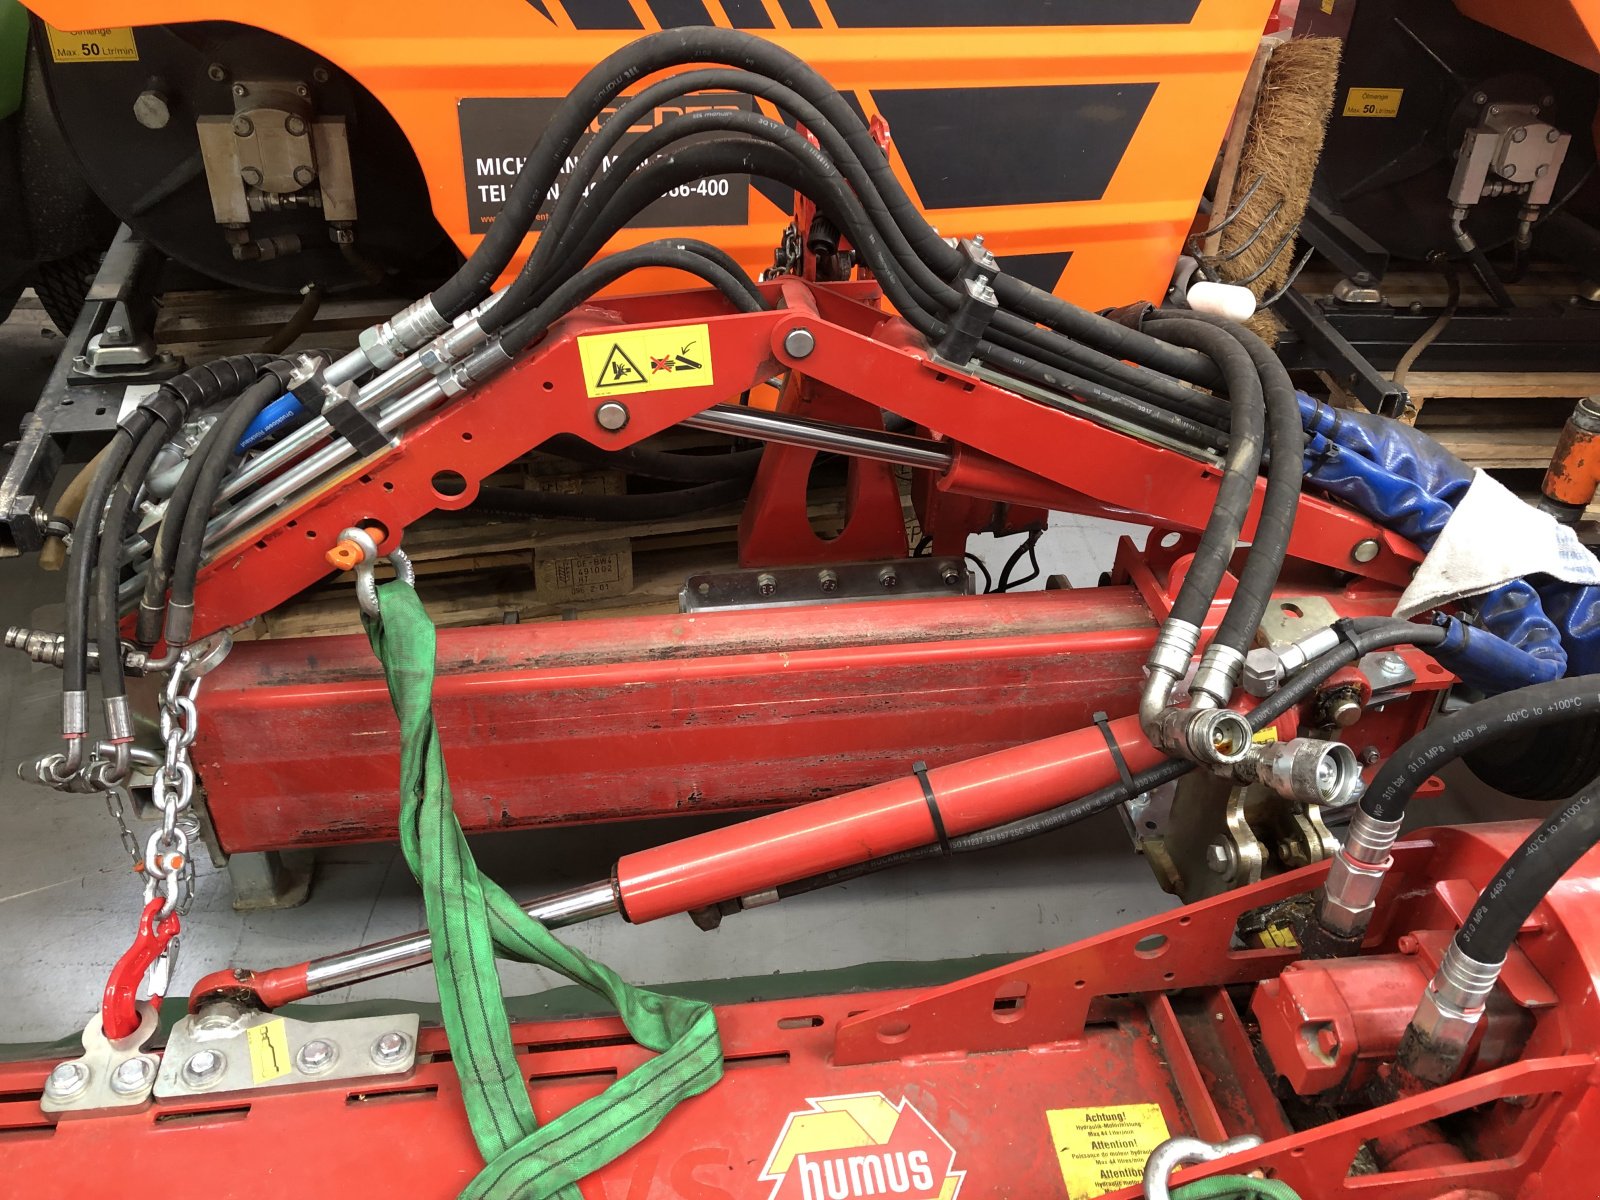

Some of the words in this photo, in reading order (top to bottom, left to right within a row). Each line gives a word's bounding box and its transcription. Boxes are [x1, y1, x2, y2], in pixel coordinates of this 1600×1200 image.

[81, 43, 100, 56] 50
[1363, 104, 1375, 114] 50
[1373, 804, 1385, 817] WP
[1382, 786, 1397, 801] 310
[1394, 774, 1407, 789] bar
[1407, 756, 1427, 774] 31.0
[1425, 744, 1446, 760] MPa
[1452, 728, 1475, 745] 4490
[1476, 723, 1489, 735] psi
[1503, 709, 1530, 724] -40°C
[1533, 705, 1543, 716] to
[1547, 697, 1583, 713] +100°C
[985, 834, 996, 843] EN
[1010, 827, 1025, 837] 2SC
[1026, 822, 1041, 833] SAE
[1041, 813, 1067, 828] 100R16
[1070, 808, 1082, 818] DN
[1082, 803, 1091, 811] 10
[1462, 924, 1476, 943] 31.0
[1473, 905, 1489, 925] MPa
[1489, 878, 1507, 901] 4490
[1505, 867, 1517, 880] psi
[1525, 834, 1548, 858] -40°C
[1547, 824, 1559, 835] to
[1559, 795, 1592, 825] +100°C
[1085, 1111, 1127, 1123] Achtung!
[1091, 1139, 1138, 1150] Attention!
[797, 1149, 934, 1200] humus
[1100, 1167, 1145, 1180] Attention
